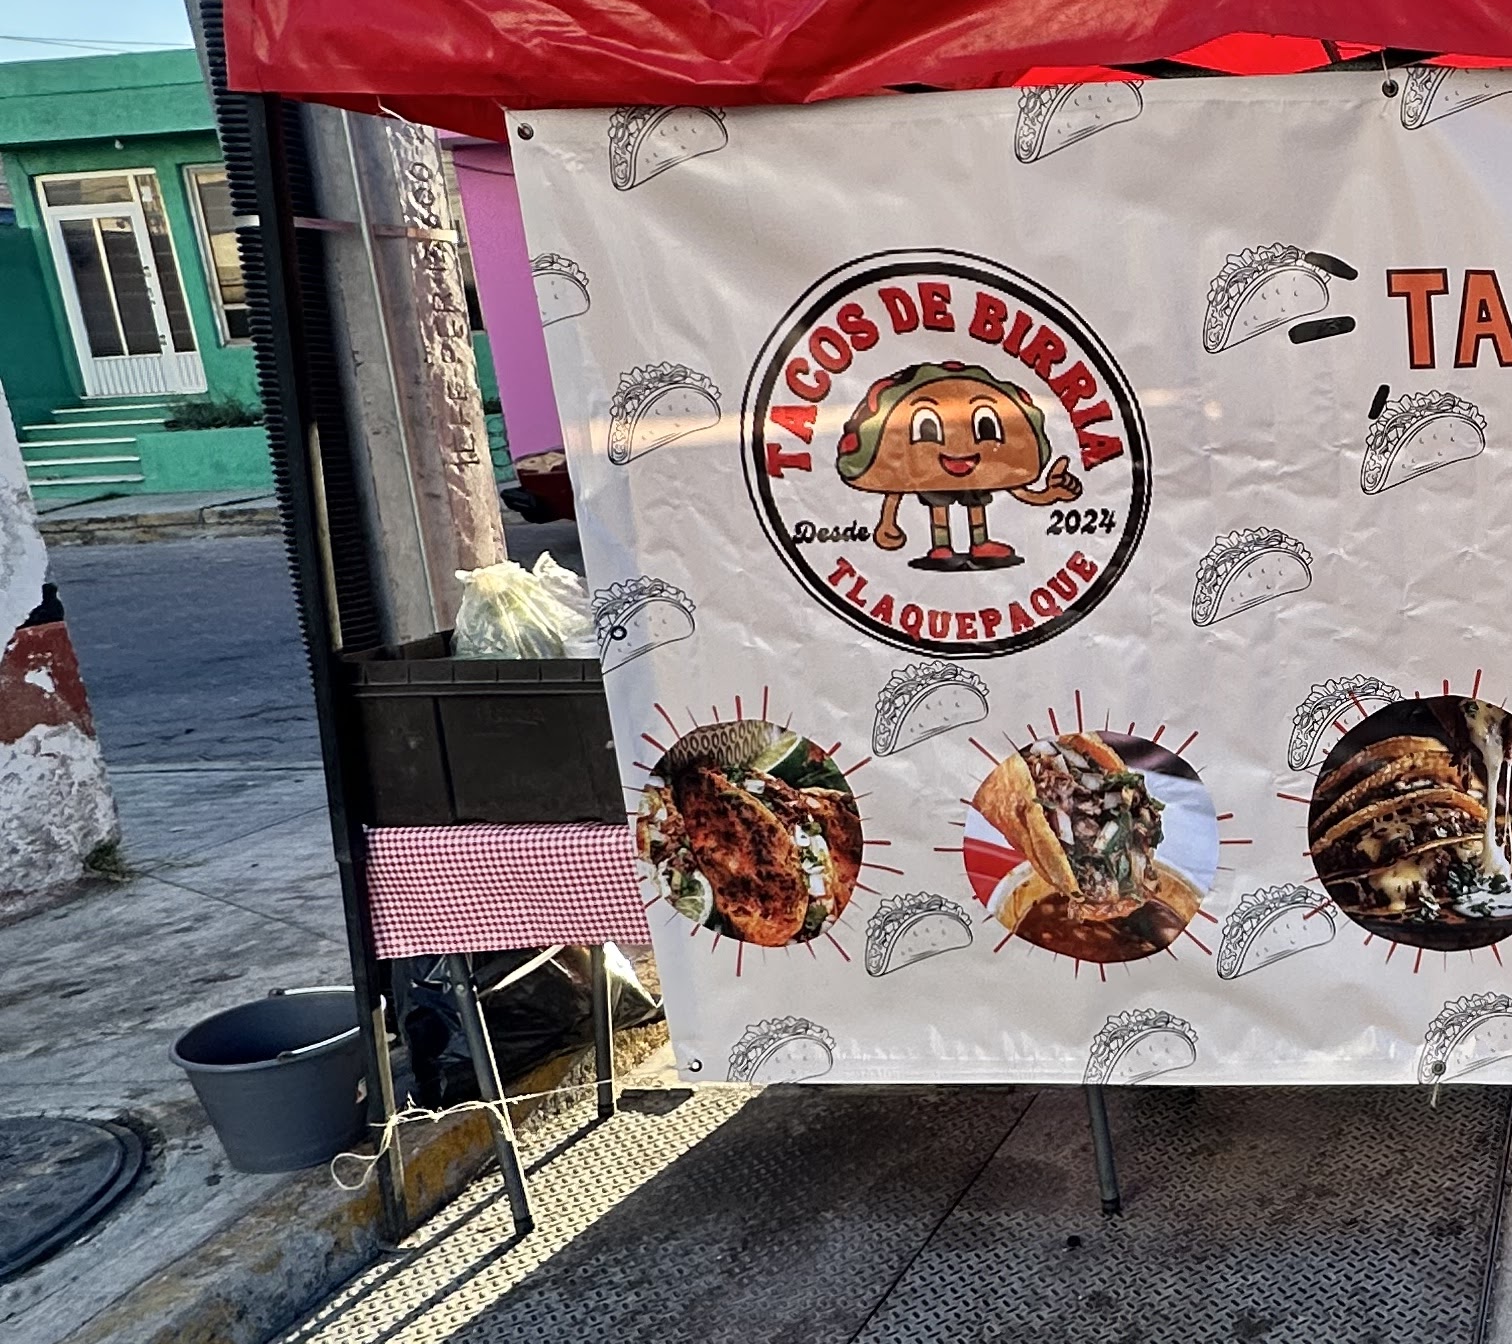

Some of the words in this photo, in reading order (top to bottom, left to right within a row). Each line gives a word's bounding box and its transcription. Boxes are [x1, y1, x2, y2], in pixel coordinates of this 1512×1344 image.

[766, 303, 880, 479] TACOS
[878, 282, 956, 335] DE
[968, 291, 1125, 472] BIRRIA
[792, 520, 871, 545] Desde
[1046, 508, 1118, 536] 2024
[827, 550, 1099, 641] TLAQUEPAQUE
